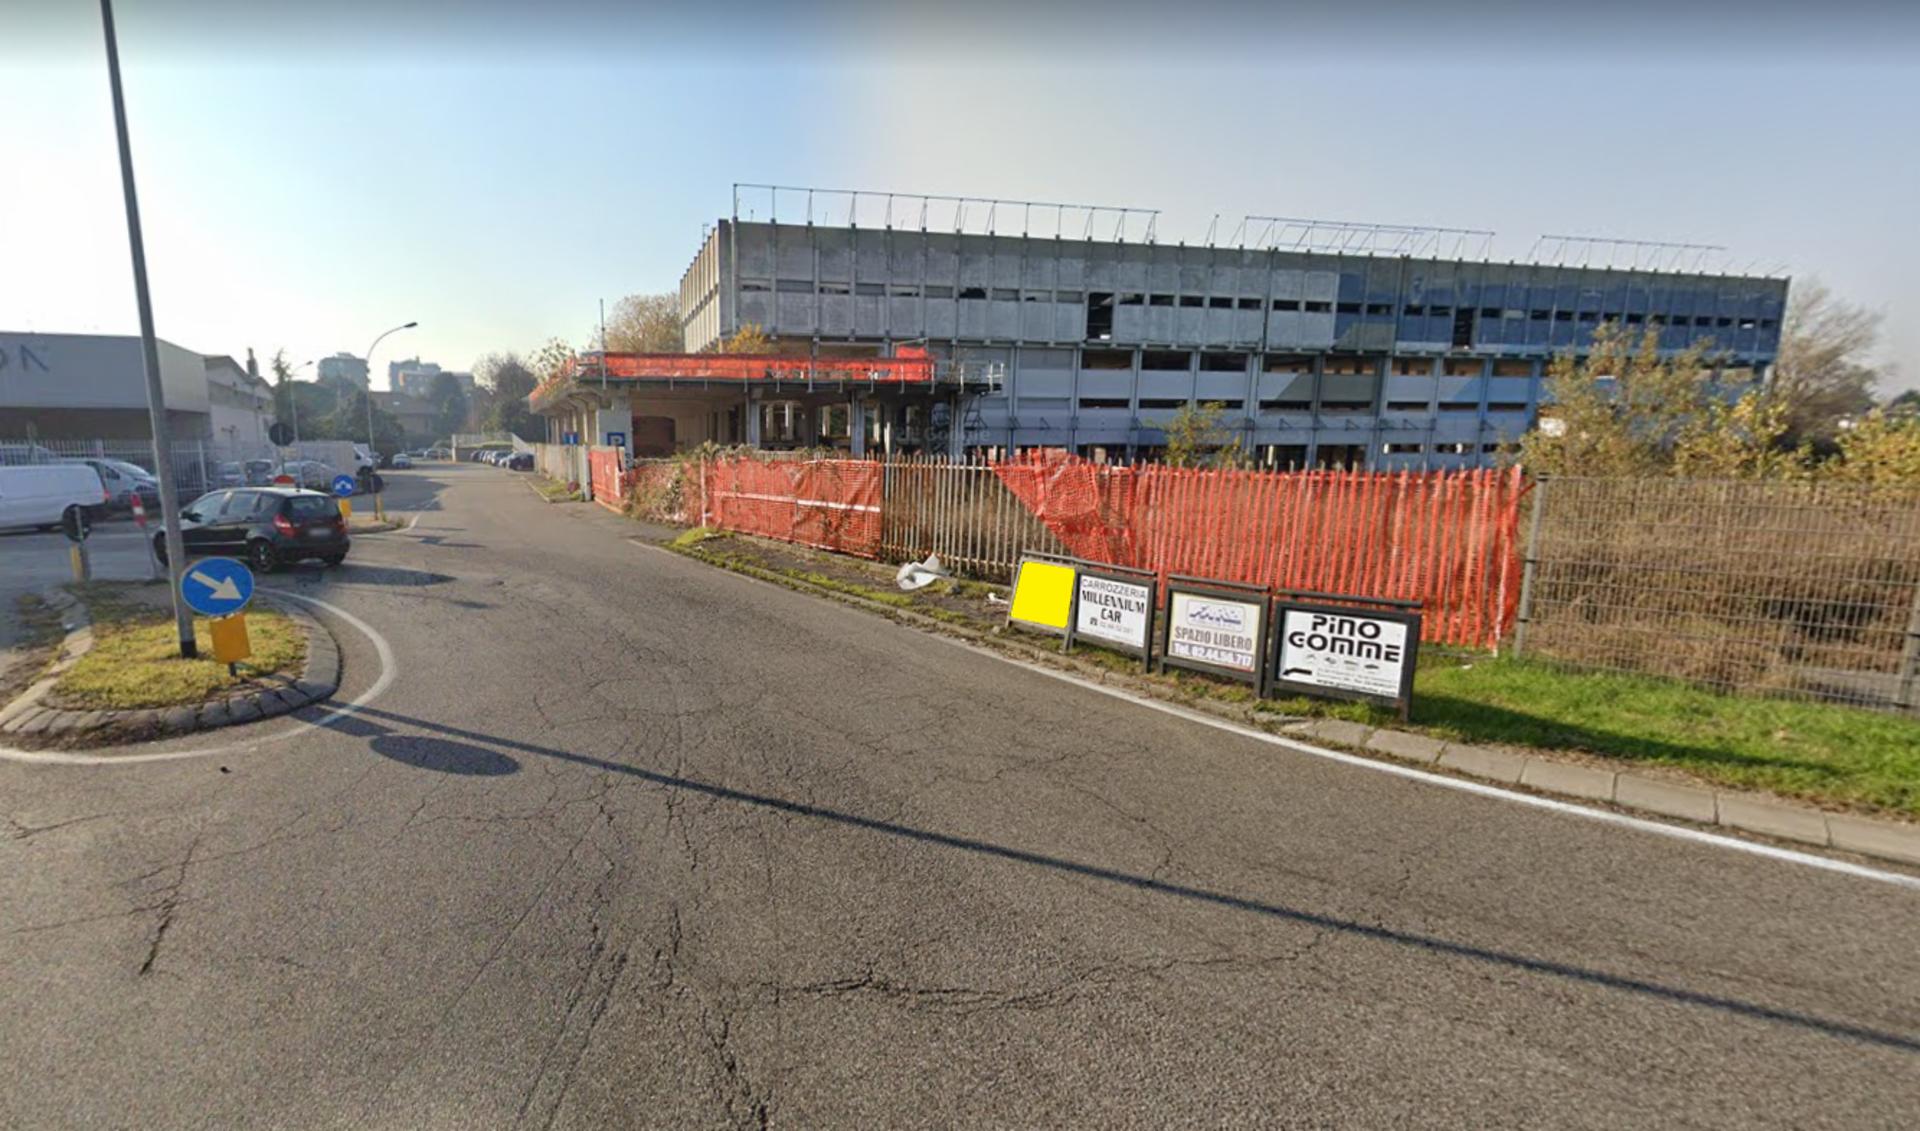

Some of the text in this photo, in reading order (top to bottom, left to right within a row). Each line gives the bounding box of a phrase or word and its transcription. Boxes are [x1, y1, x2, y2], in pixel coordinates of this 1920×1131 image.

[1082, 579, 1147, 599] CARROZZERIA
[1082, 590, 1145, 614] MILLENNIUM
[1100, 608, 1122, 624] CAR
[1175, 625, 1252, 651] SPAZIO LIBERO
[1289, 631, 1400, 663] GOMME
